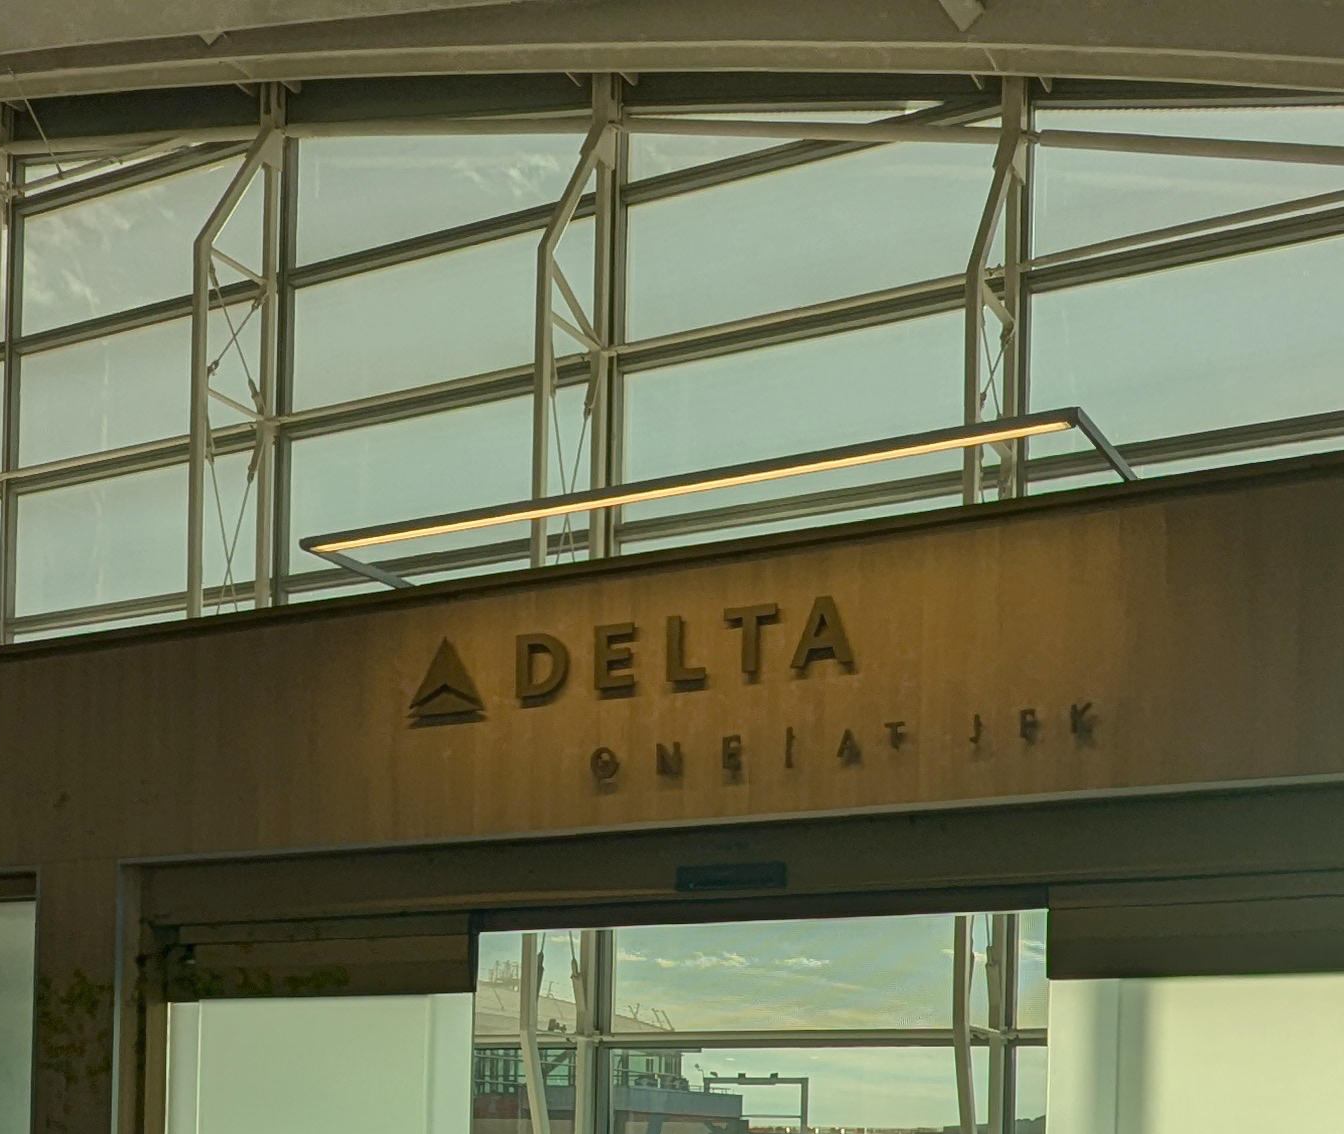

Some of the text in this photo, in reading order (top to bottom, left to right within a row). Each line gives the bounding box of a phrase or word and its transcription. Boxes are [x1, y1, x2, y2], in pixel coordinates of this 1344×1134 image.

[515, 595, 855, 699] DELTA
[589, 734, 742, 779] ONE
[836, 720, 906, 763] AT
[969, 702, 1096, 745] JFK
